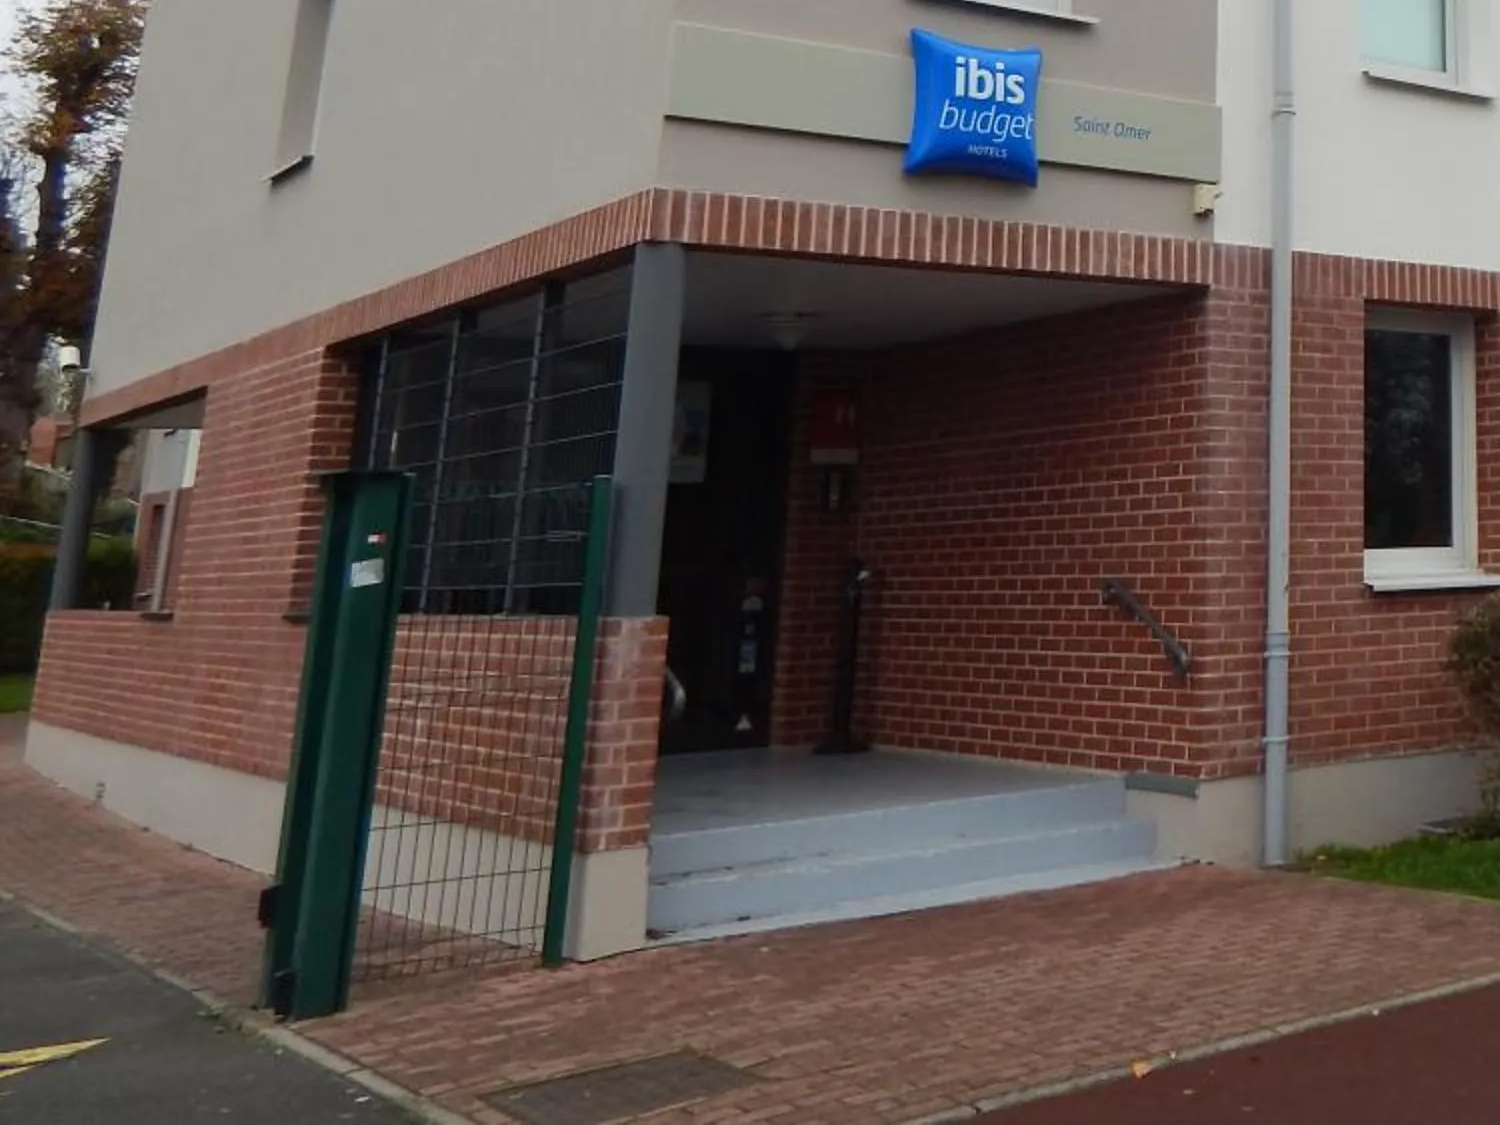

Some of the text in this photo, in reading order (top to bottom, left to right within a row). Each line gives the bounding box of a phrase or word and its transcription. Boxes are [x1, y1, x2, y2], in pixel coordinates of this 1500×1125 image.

[956, 56, 1025, 104] ibis
[939, 98, 1036, 142] budget
[1074, 116, 1152, 140] Saint Omer
[968, 145, 1009, 158] HOTELS
